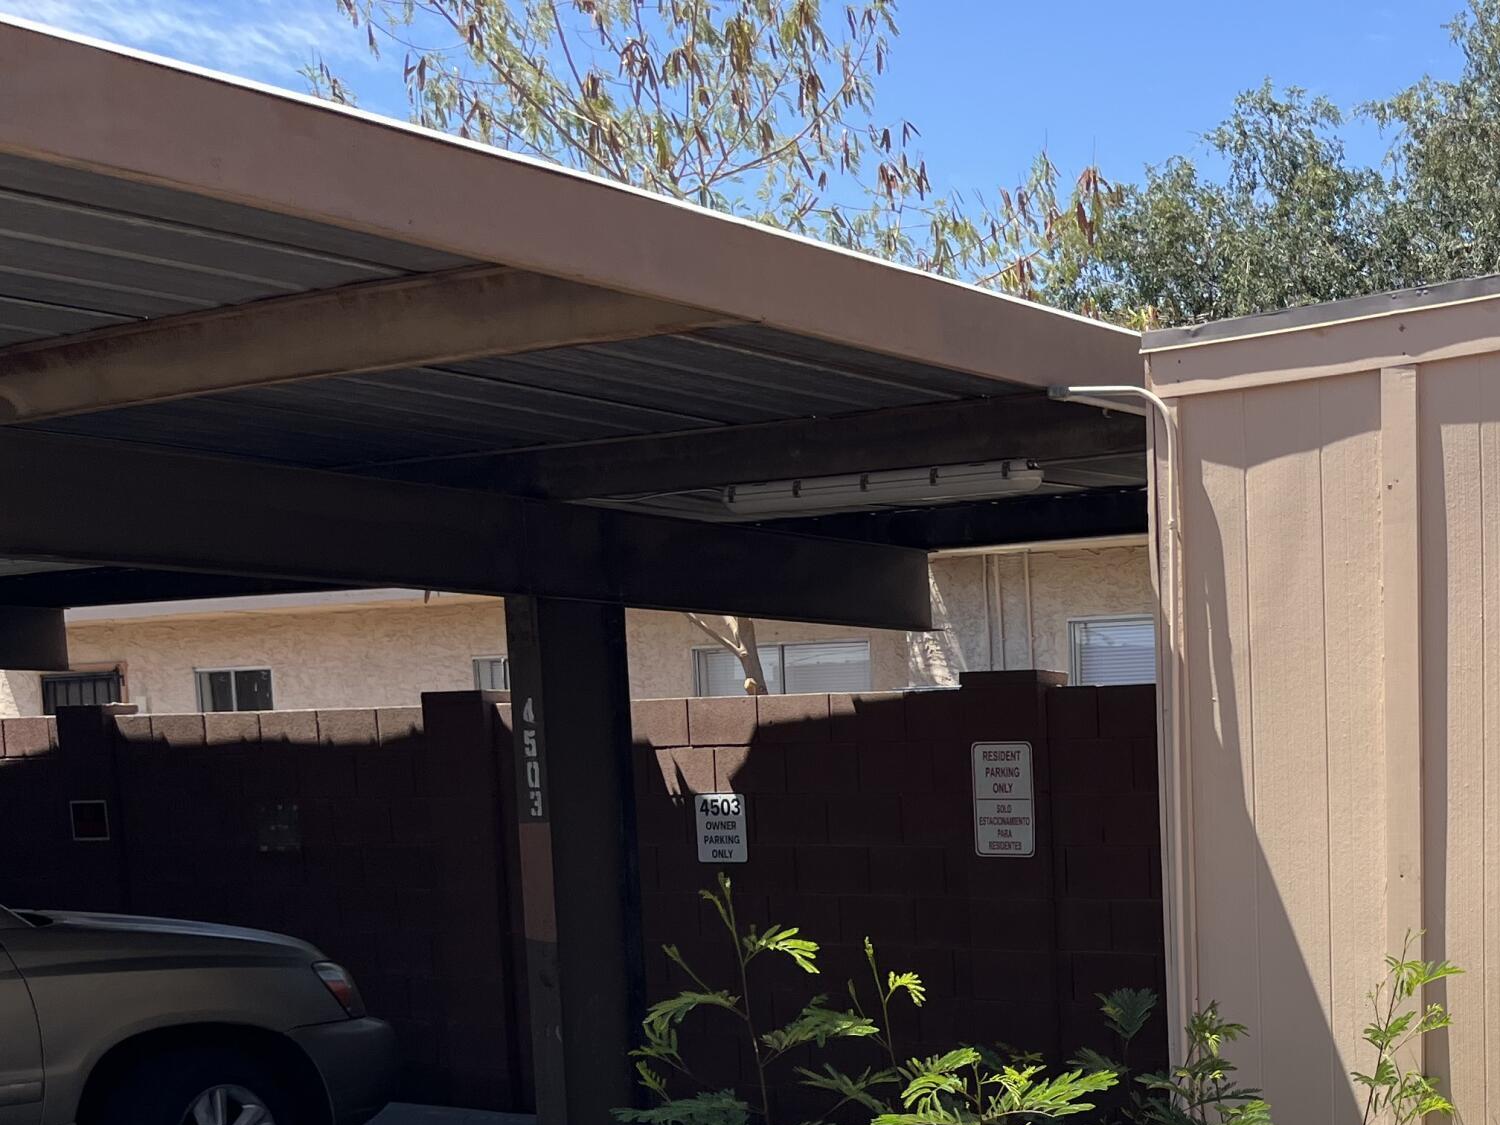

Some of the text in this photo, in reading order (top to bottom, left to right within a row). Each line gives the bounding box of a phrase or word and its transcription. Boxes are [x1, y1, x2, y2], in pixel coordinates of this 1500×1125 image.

[522, 697, 542, 816] 4503
[982, 750, 1021, 761] RESIDENT
[985, 767, 1020, 778] PARKING
[992, 782, 1014, 794] ONLY
[700, 798, 741, 816] 4503
[996, 804, 1012, 814] SOLO
[705, 821, 737, 831] OWNER
[997, 829, 1012, 838] PARA
[704, 835, 740, 844] PARKING
[711, 849, 733, 859] ONLY
